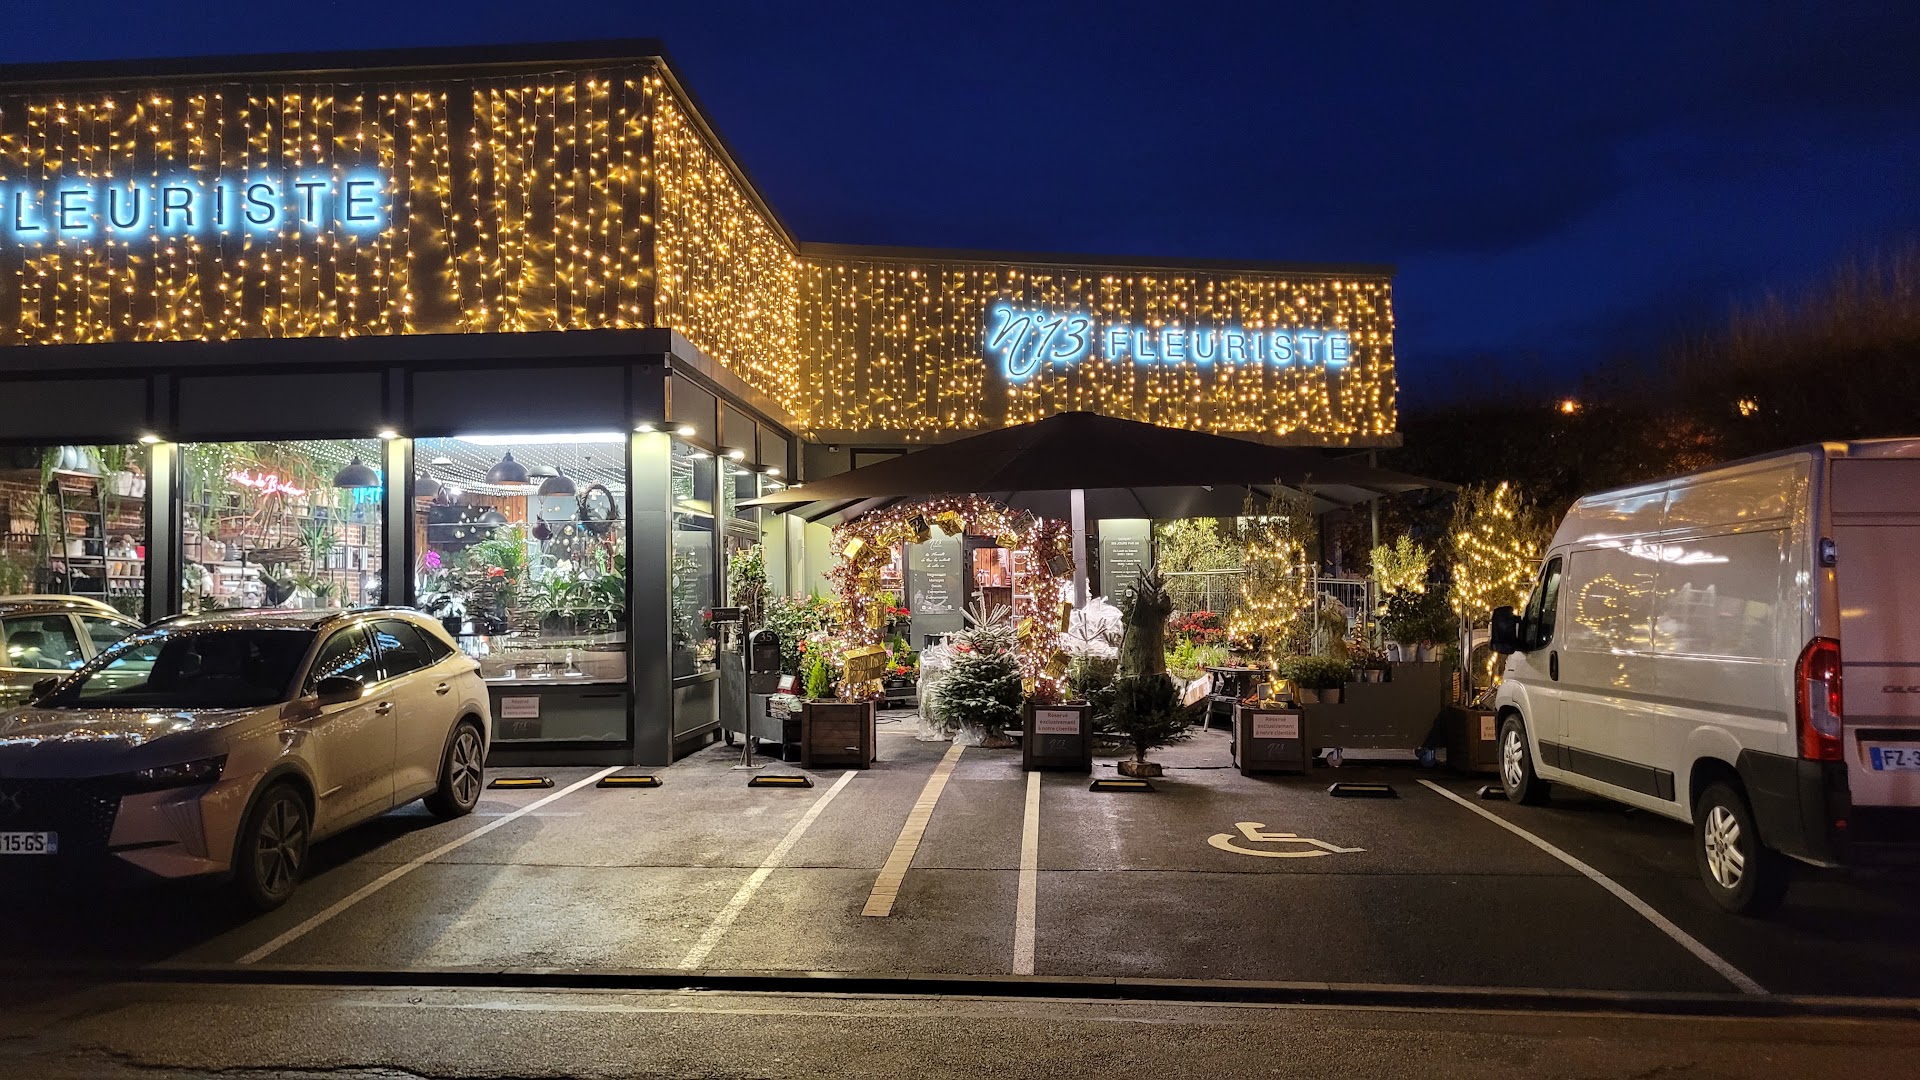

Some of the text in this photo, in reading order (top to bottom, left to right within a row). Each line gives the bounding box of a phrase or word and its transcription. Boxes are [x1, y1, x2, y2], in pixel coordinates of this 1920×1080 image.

[14, 181, 375, 231] LEURISTE
[1111, 331, 1348, 361] FLEURISTE
[760, 632, 773, 642] 35
[1884, 749, 1920, 767] FZ-3
[0, 834, 44, 851] 15-GS
